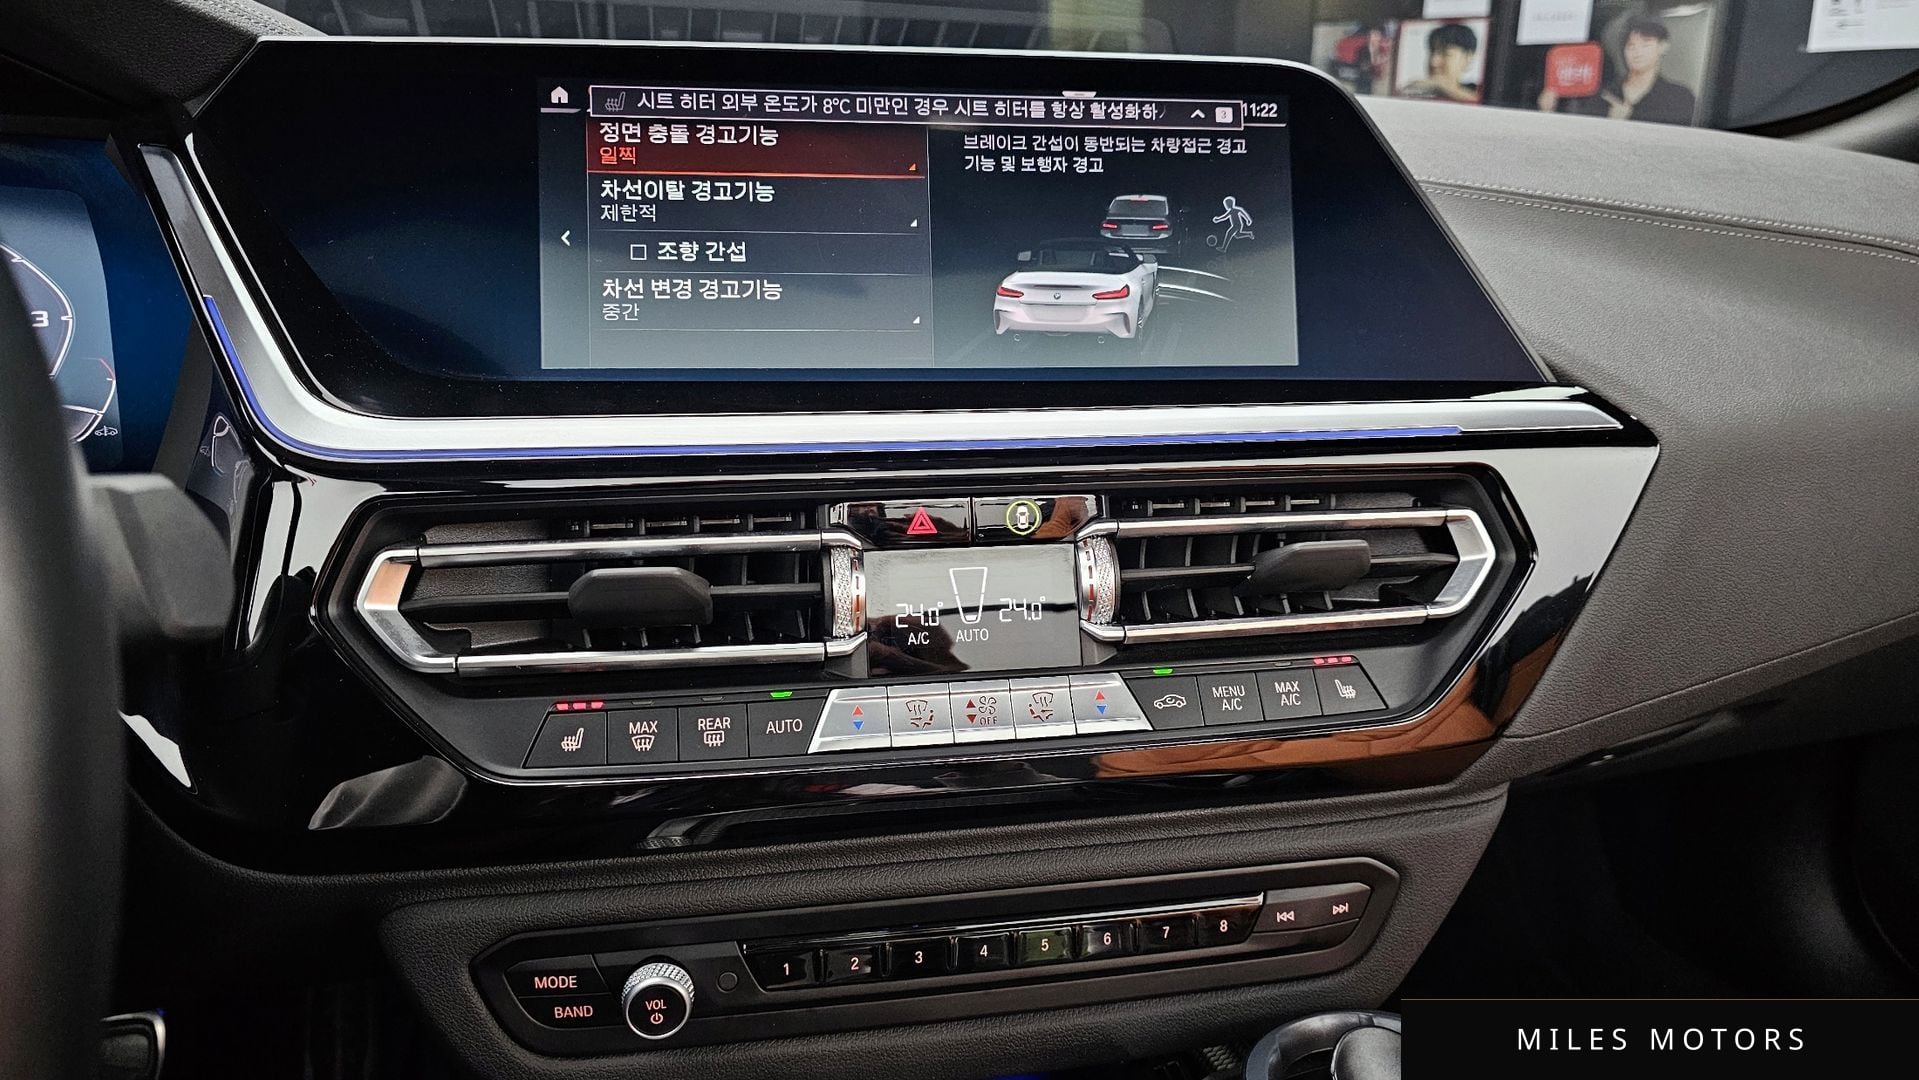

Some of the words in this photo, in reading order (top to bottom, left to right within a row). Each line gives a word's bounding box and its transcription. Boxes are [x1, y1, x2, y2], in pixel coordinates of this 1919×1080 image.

[637, 91, 675, 110] 시트
[680, 92, 716, 111] 히터
[721, 93, 758, 112] 외부
[763, 93, 818, 113] 온도가
[856, 97, 908, 115] 미만인
[914, 97, 949, 117] 경우
[954, 99, 989, 117] 시트
[995, 99, 1046, 118] 히터를
[1050, 100, 1085, 119] 항상
[1242, 103, 1278, 118] 11:22
[599, 122, 641, 143] 정면
[648, 123, 689, 144] 충돌
[695, 124, 779, 146] 경고기능
[963, 134, 1027, 151] 브레이크
[1032, 134, 1079, 152] 간섭이
[1084, 136, 1146, 153] 동반되는
[1151, 137, 1212, 154] 차량접근
[1216, 138, 1248, 155] 경고
[599, 146, 636, 165] 일찍
[964, 155, 996, 172] 기능
[1001, 155, 1016, 172] 및
[1021, 156, 1068, 173] 보행자
[1073, 156, 1104, 173] 경고
[600, 178, 685, 201] 차선이탈
[691, 180, 775, 203] 경고기능
[600, 203, 657, 223] 제한적
[656, 240, 700, 262] 조향
[705, 240, 747, 263] 간섭
[602, 277, 645, 300] 차선
[651, 278, 692, 300] 변경
[698, 279, 783, 301] 경고기능
[31, 310, 49, 328] 3
[601, 302, 640, 322] 중간
[907, 631, 930, 645] A/C
[955, 628, 990, 643] AUTO
[1212, 685, 1246, 698] MENU
[1274, 680, 1301, 694] MAX
[1222, 698, 1243, 711] A/C
[1280, 693, 1302, 707] A/C
[629, 720, 658, 735] MAX
[697, 717, 731, 731] REAR
[766, 718, 803, 735] AUTO
[979, 715, 998, 726] OFF
[783, 962, 790, 976] 1
[850, 957, 859, 971] 2
[914, 951, 923, 965] 3
[980, 944, 989, 958] 4
[1041, 938, 1049, 952] 5
[1103, 932, 1112, 945] 6
[1162, 926, 1170, 940] 7
[1219, 920, 1228, 933] 8
[534, 974, 578, 990] MODE
[554, 1005, 594, 1019] BAND
[645, 1000, 667, 1011] VOL
